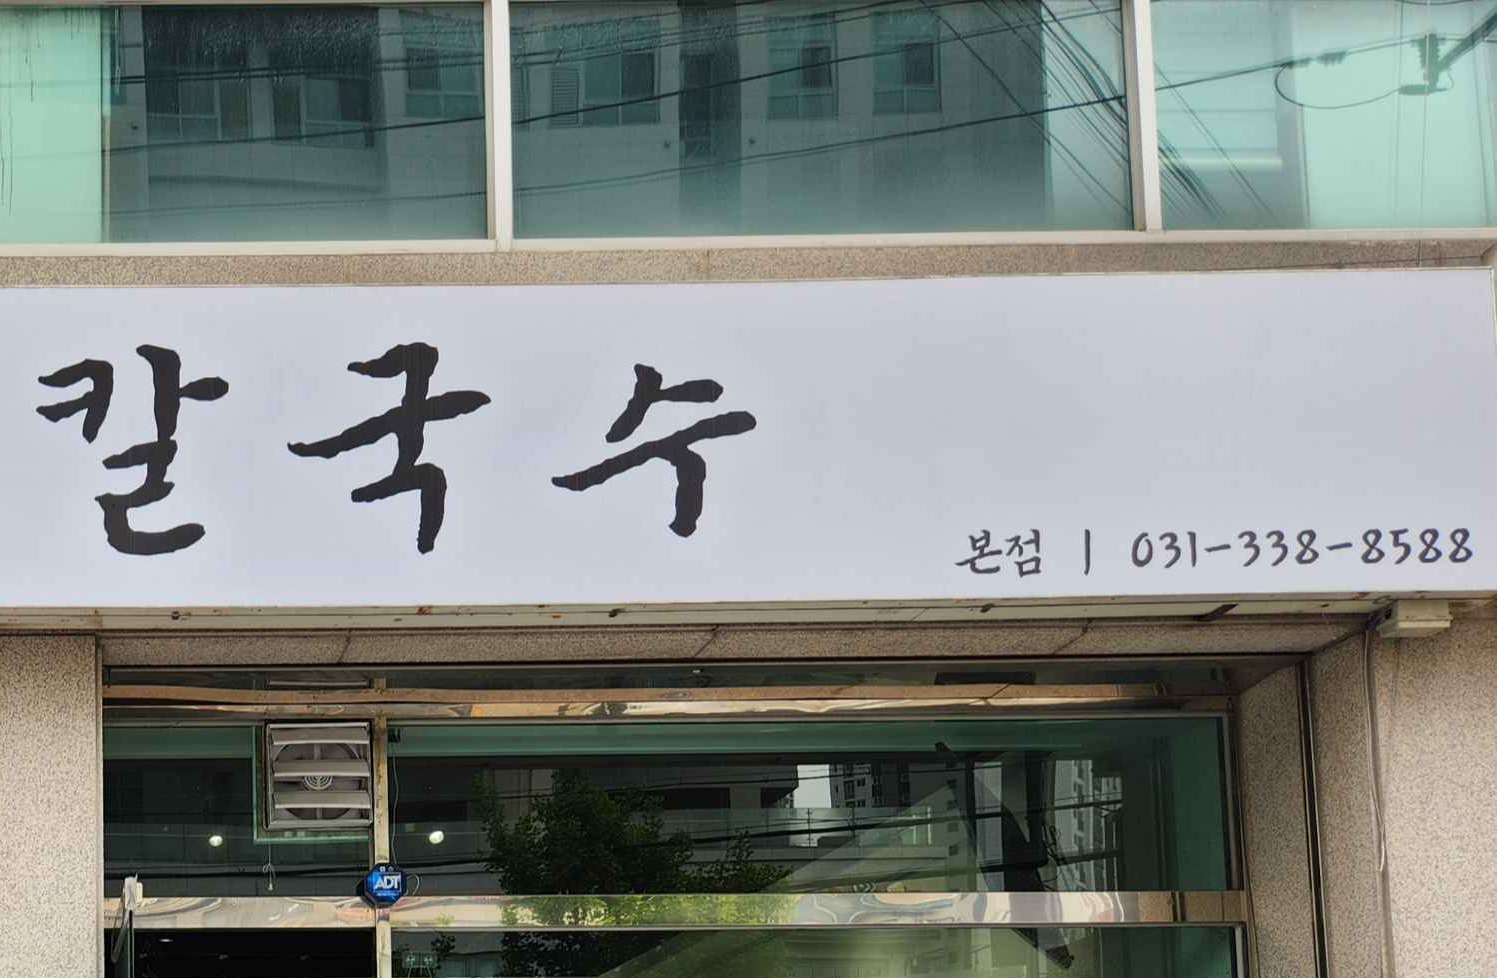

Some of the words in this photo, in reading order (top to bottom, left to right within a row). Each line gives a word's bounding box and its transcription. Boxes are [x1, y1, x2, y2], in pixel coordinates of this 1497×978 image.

[955, 528, 1042, 578] 본점
[1130, 527, 1474, 569] 031-338-8588
[373, 874, 402, 890] ADT
